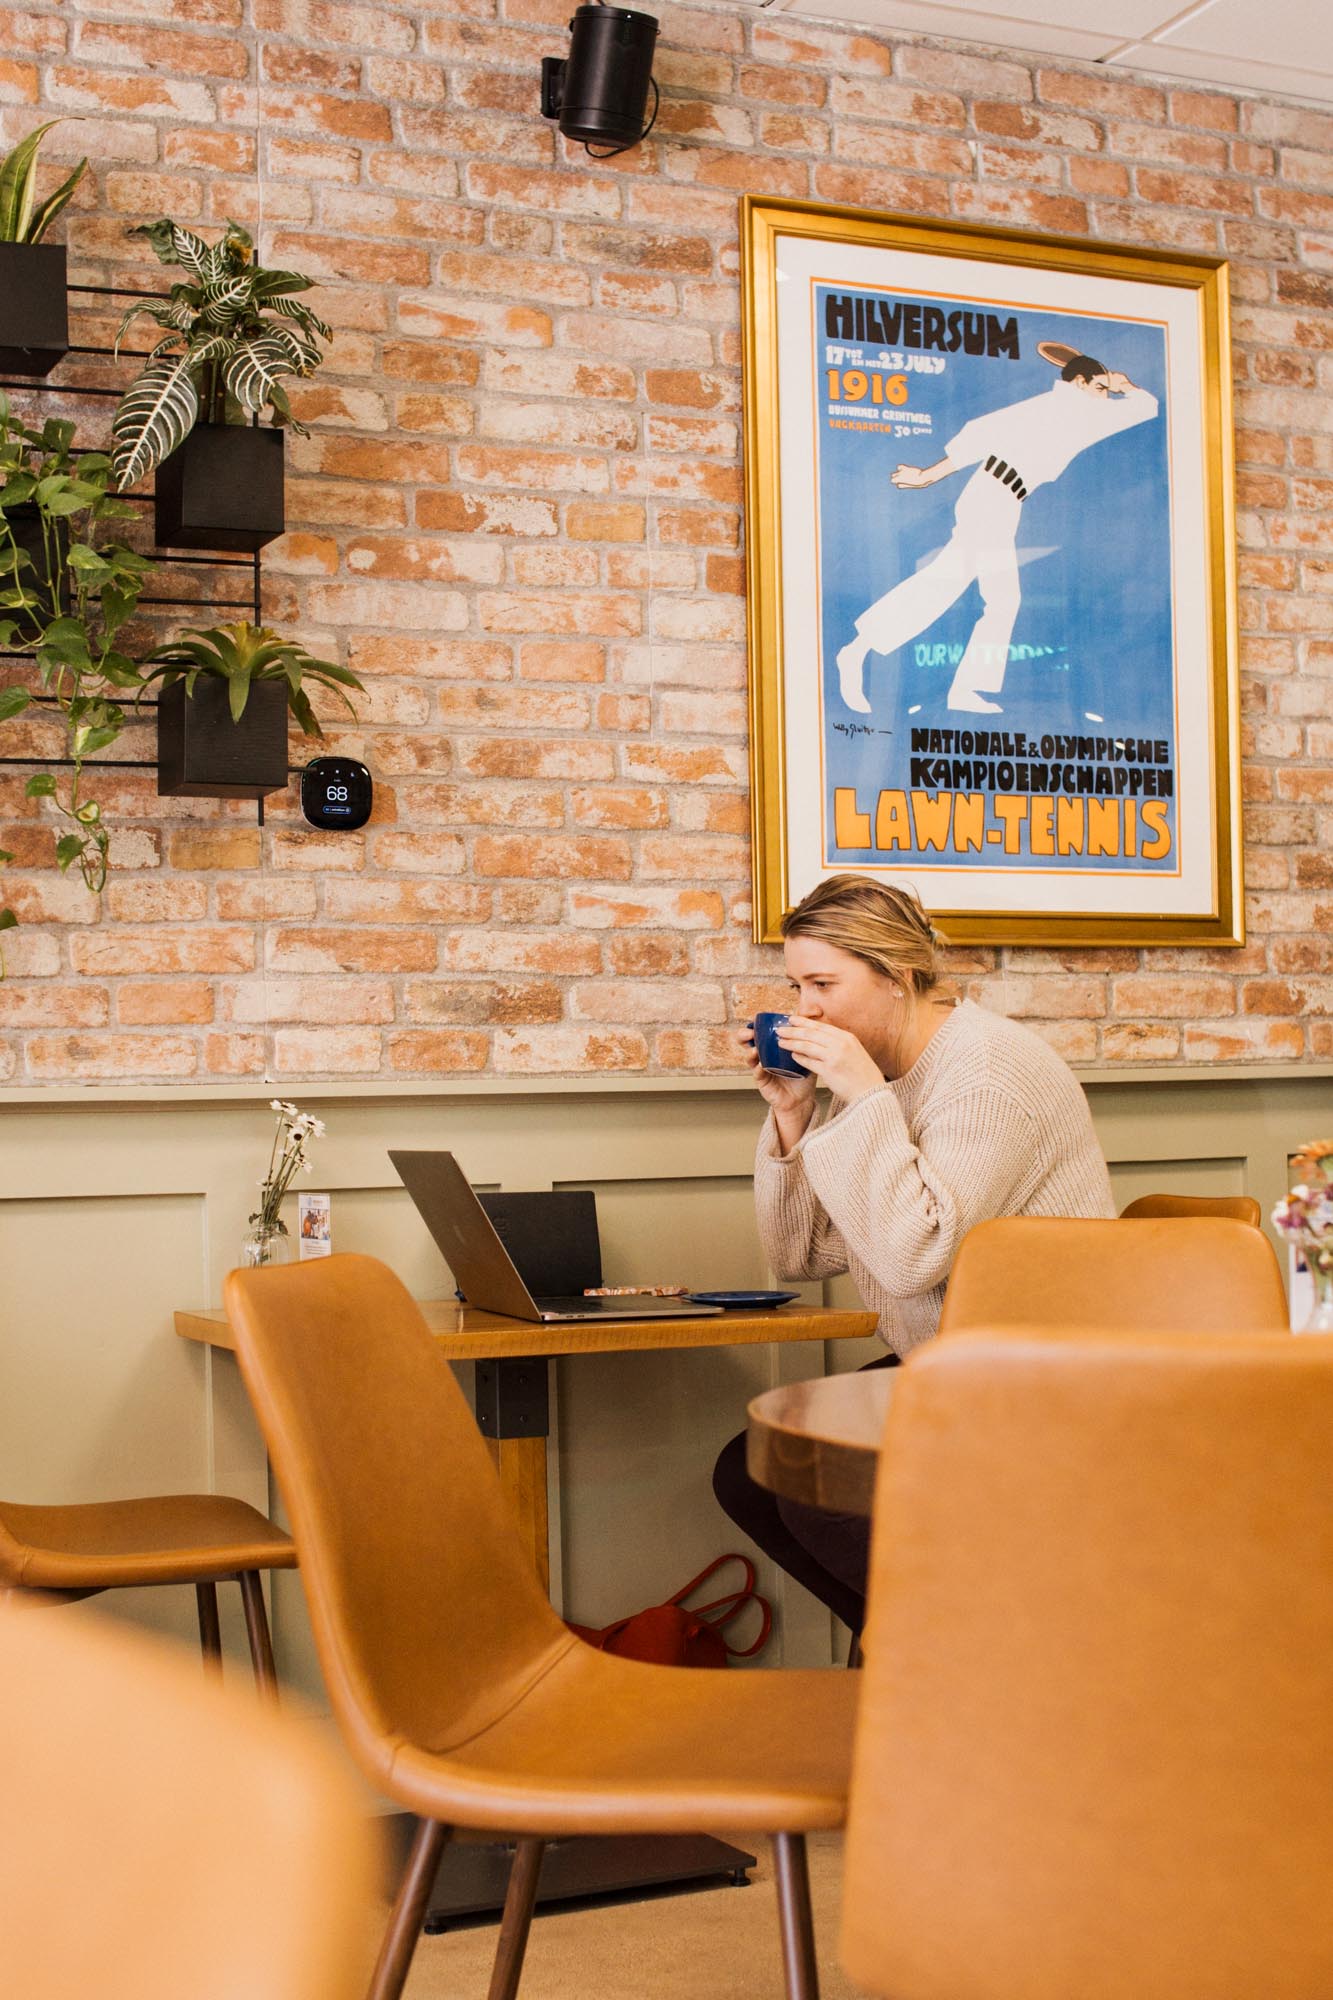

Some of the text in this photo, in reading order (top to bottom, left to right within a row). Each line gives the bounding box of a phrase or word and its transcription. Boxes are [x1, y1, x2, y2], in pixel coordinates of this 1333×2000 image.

[825, 294, 1020, 360] HILVERSUM
[825, 345, 844, 366] 17
[879, 351, 904, 370] 23
[903, 354, 946, 375] JULY
[825, 368, 909, 407] 1916
[911, 727, 1027, 758] NATIONALE
[1040, 734, 1169, 764] OLYMPISCHE
[326, 785, 348, 802] 68
[910, 757, 1173, 797] KAMPIOENSCHAPPEN
[834, 786, 1172, 860] LAWN-TENNIS
